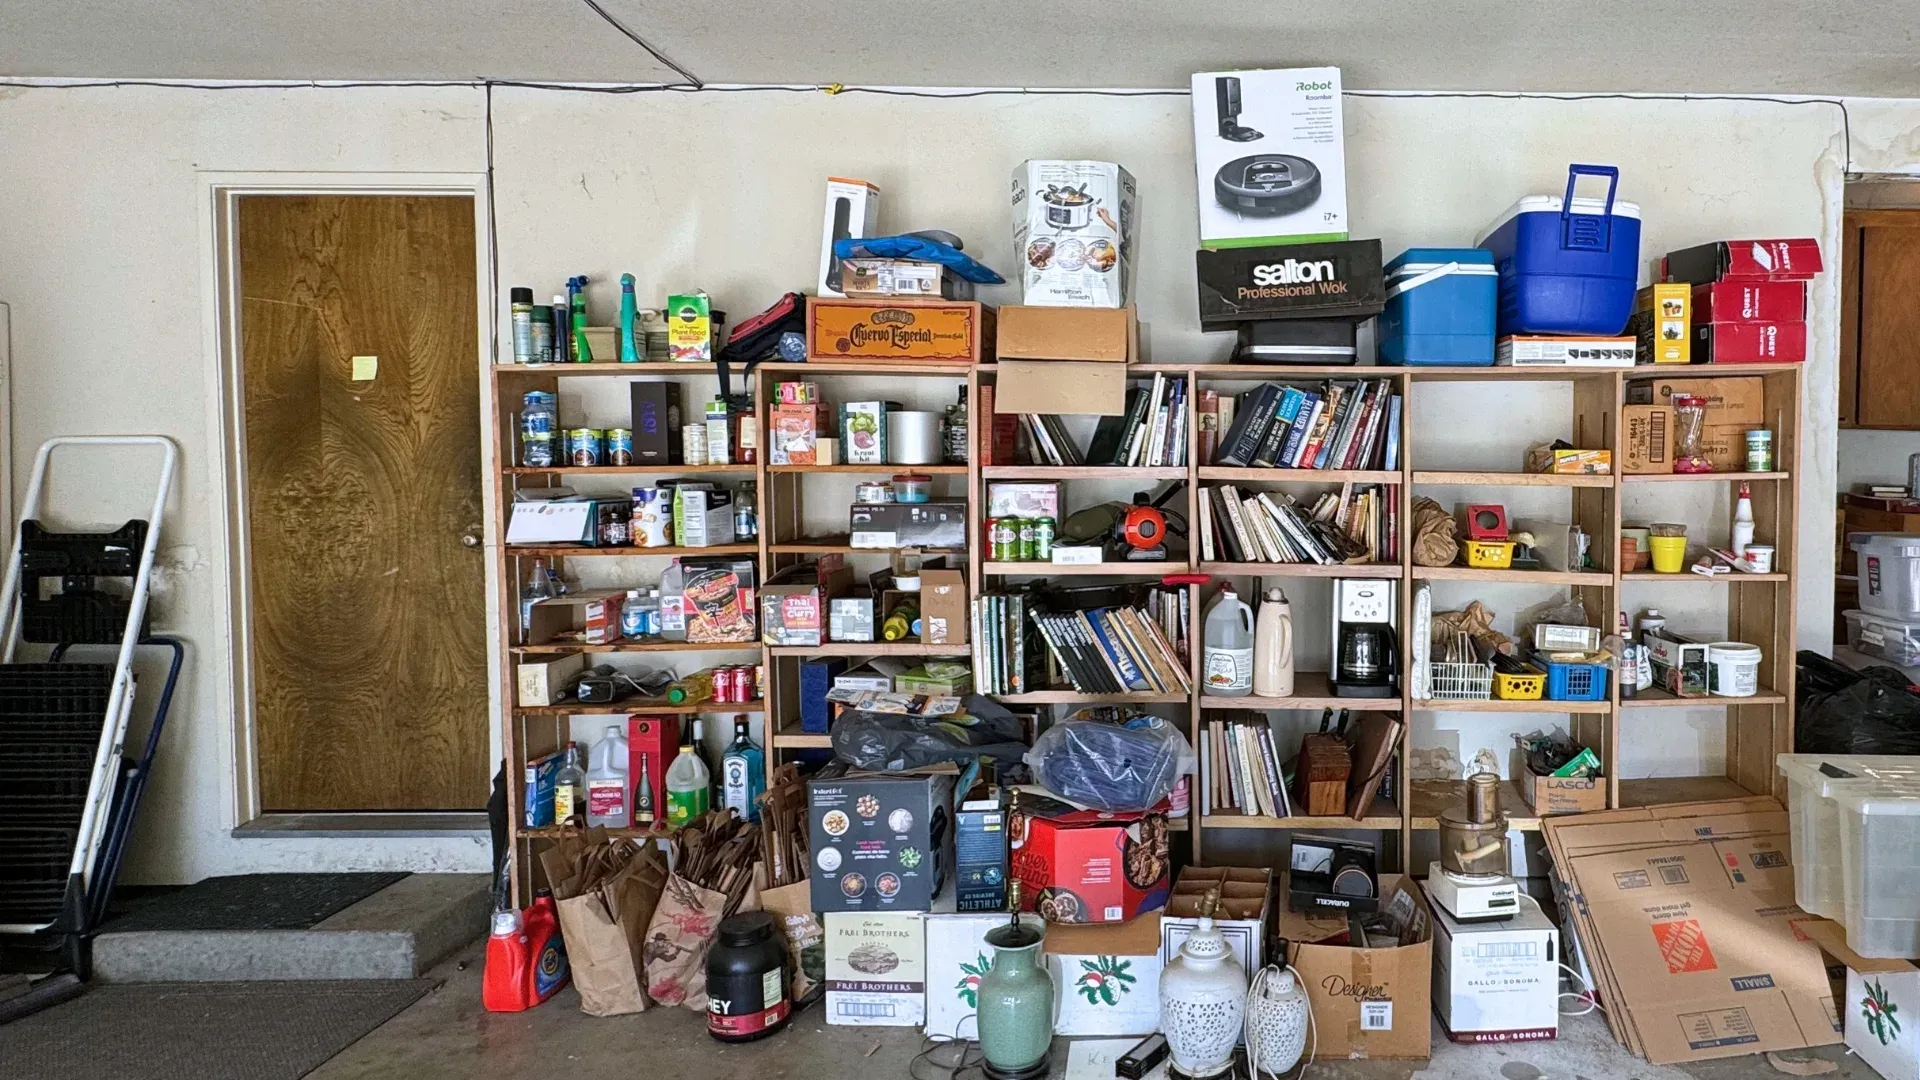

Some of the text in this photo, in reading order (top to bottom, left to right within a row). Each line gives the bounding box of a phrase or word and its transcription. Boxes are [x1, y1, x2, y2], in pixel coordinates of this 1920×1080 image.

[1296, 81, 1332, 91] iRobot
[1324, 212, 1338, 221] i7+
[1778, 243, 1791, 270] QUEST
[1253, 258, 1335, 286] salton
[1237, 281, 1348, 300] Professional Wok
[1742, 287, 1752, 319] QUEST
[689, 328, 707, 336] Food
[849, 322, 932, 350] Cuervo Especial
[1767, 325, 1778, 357] QUEST
[1294, 397, 1315, 430] HAMMER
[787, 598, 810, 607] Thai
[1546, 780, 1596, 790] LASCO
[959, 899, 1002, 910] ATHLETIC
[1316, 898, 1350, 908] DURACELL
[839, 929, 910, 938] FREI BROTHERS
[1668, 920, 1701, 970] HOME
[836, 981, 912, 991] FREI BROTHERS
[1733, 976, 1771, 989] SMALL
[1322, 975, 1387, 1003] Designer
[1475, 1033, 1506, 1042] GALLO
[1512, 1031, 1551, 1040] SONOMA
